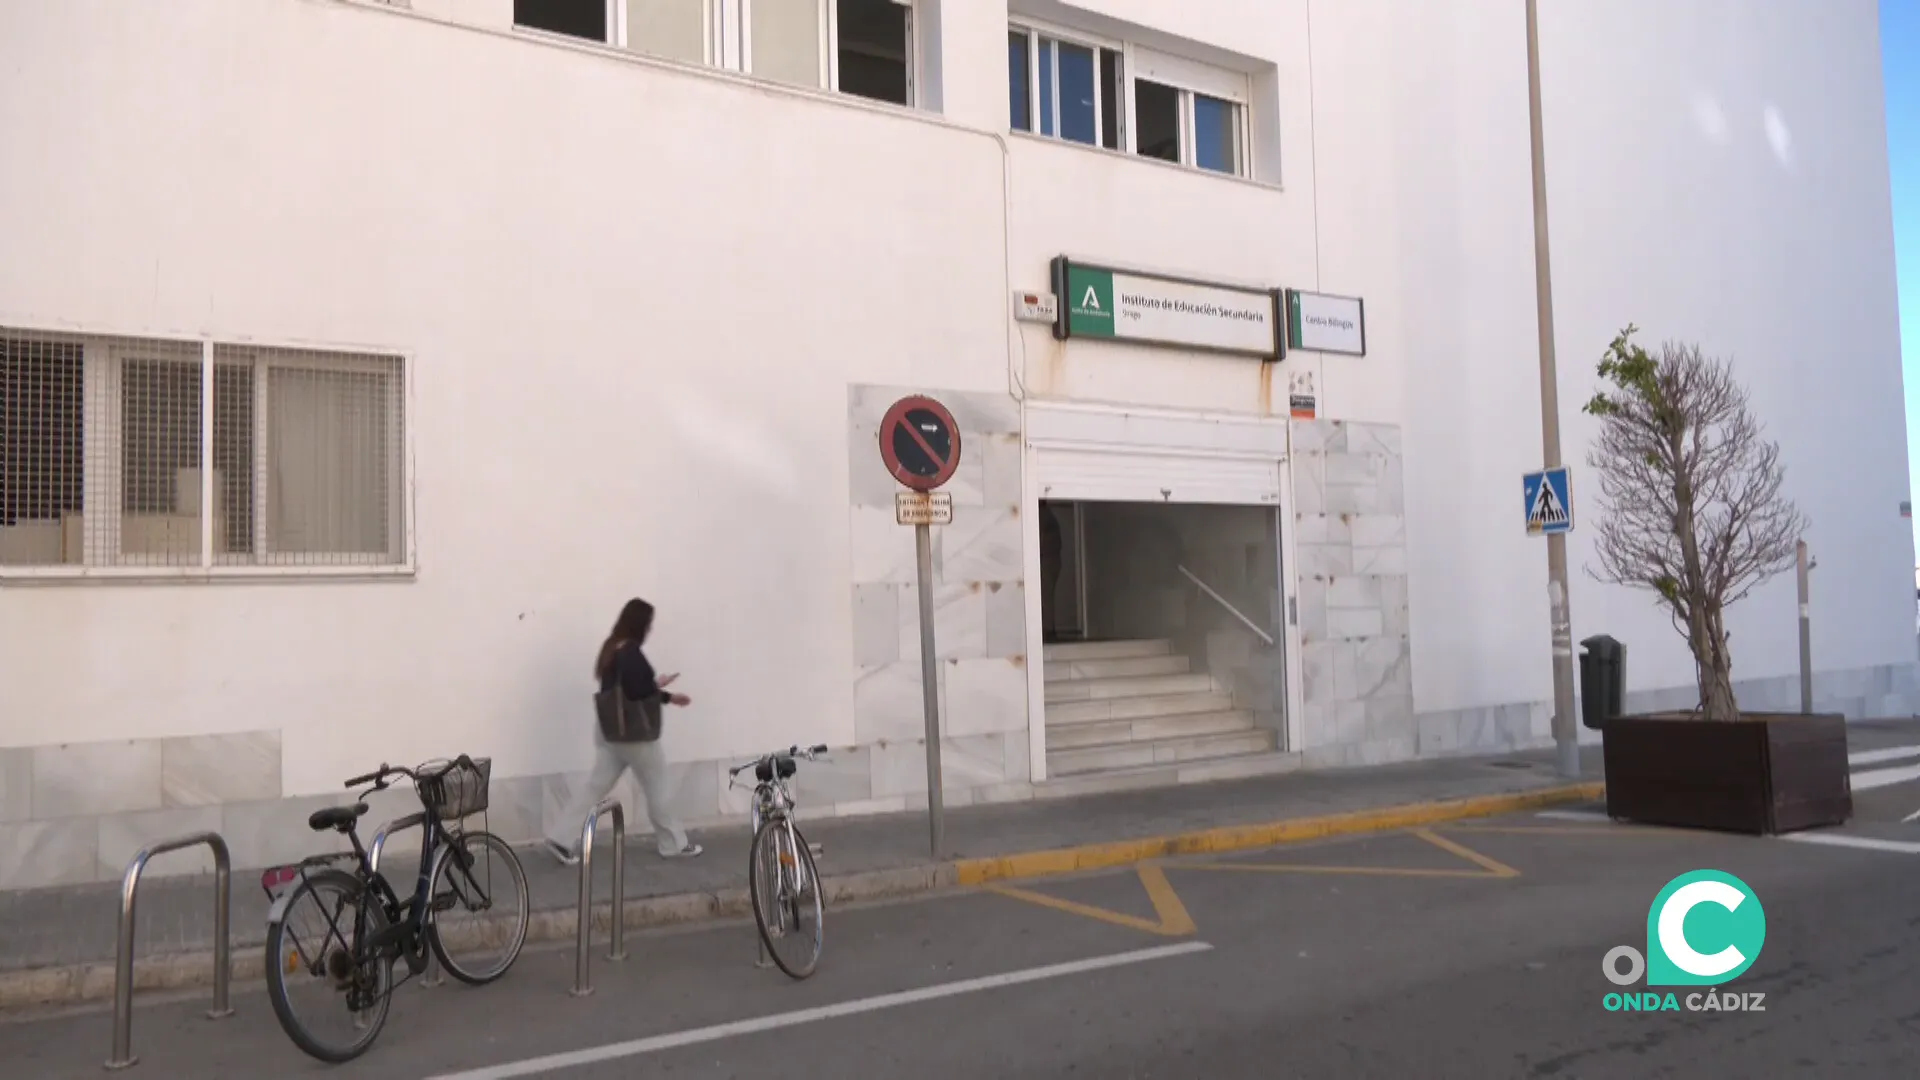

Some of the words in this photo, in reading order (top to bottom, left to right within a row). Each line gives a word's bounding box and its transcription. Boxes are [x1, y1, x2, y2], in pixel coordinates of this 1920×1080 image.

[1121, 293, 1160, 310] Instituto
[1161, 298, 1173, 310] de
[1174, 300, 1217, 316] Educación
[1219, 307, 1264, 323] Secundaria
[1305, 315, 1328, 326] Centro
